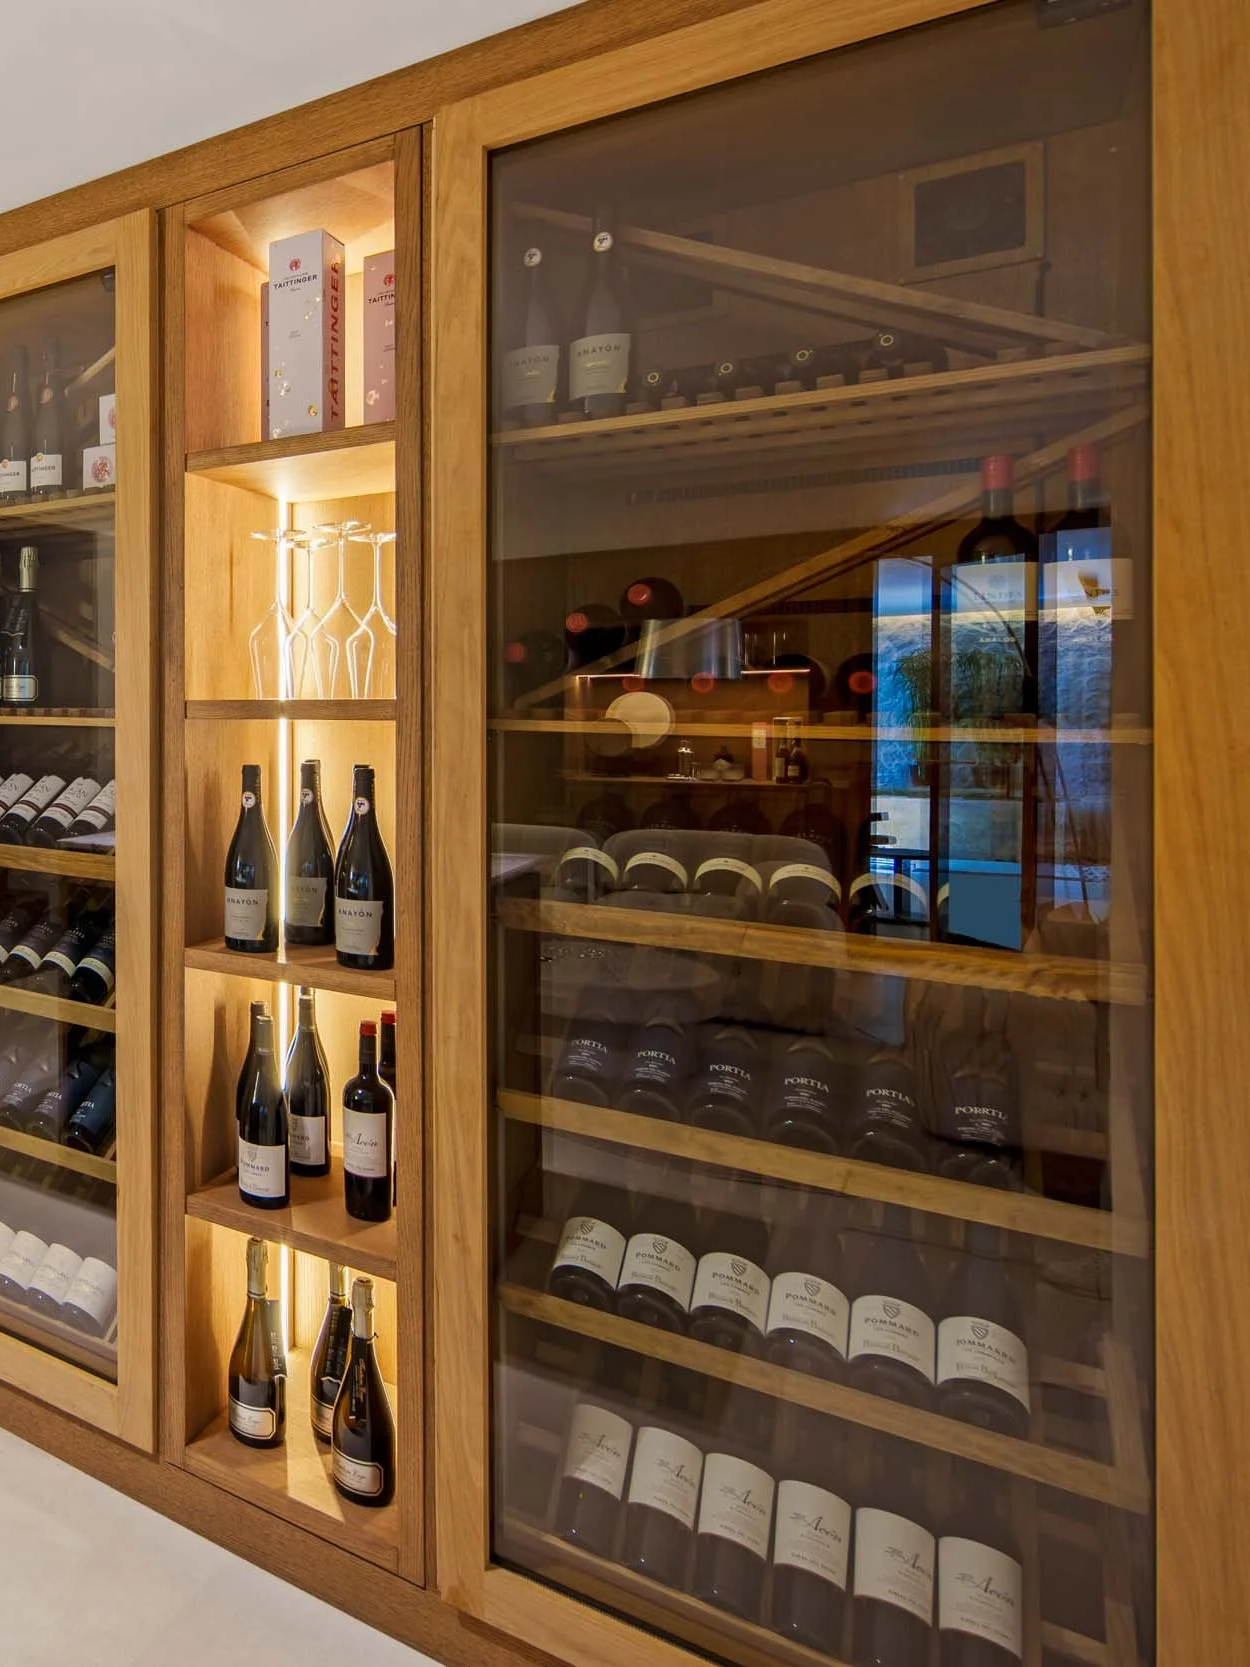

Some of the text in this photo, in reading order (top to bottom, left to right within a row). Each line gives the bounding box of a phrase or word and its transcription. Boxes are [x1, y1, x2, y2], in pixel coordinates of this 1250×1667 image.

[273, 274, 318, 290] TAITTINGER
[330, 262, 342, 421] TAITTINGER
[571, 1038, 607, 1054] PORTIA
[637, 1049, 676, 1065] PORTIA
[709, 1063, 751, 1081] PORTIA
[784, 1076, 830, 1093] PORTIA
[866, 1088, 913, 1106] PORTIA
[635, 1252, 680, 1271] POMMARD
[712, 1272, 760, 1295] POMMARD
[785, 1292, 837, 1316] POMMARD
[864, 1316, 920, 1337] POMMARD
